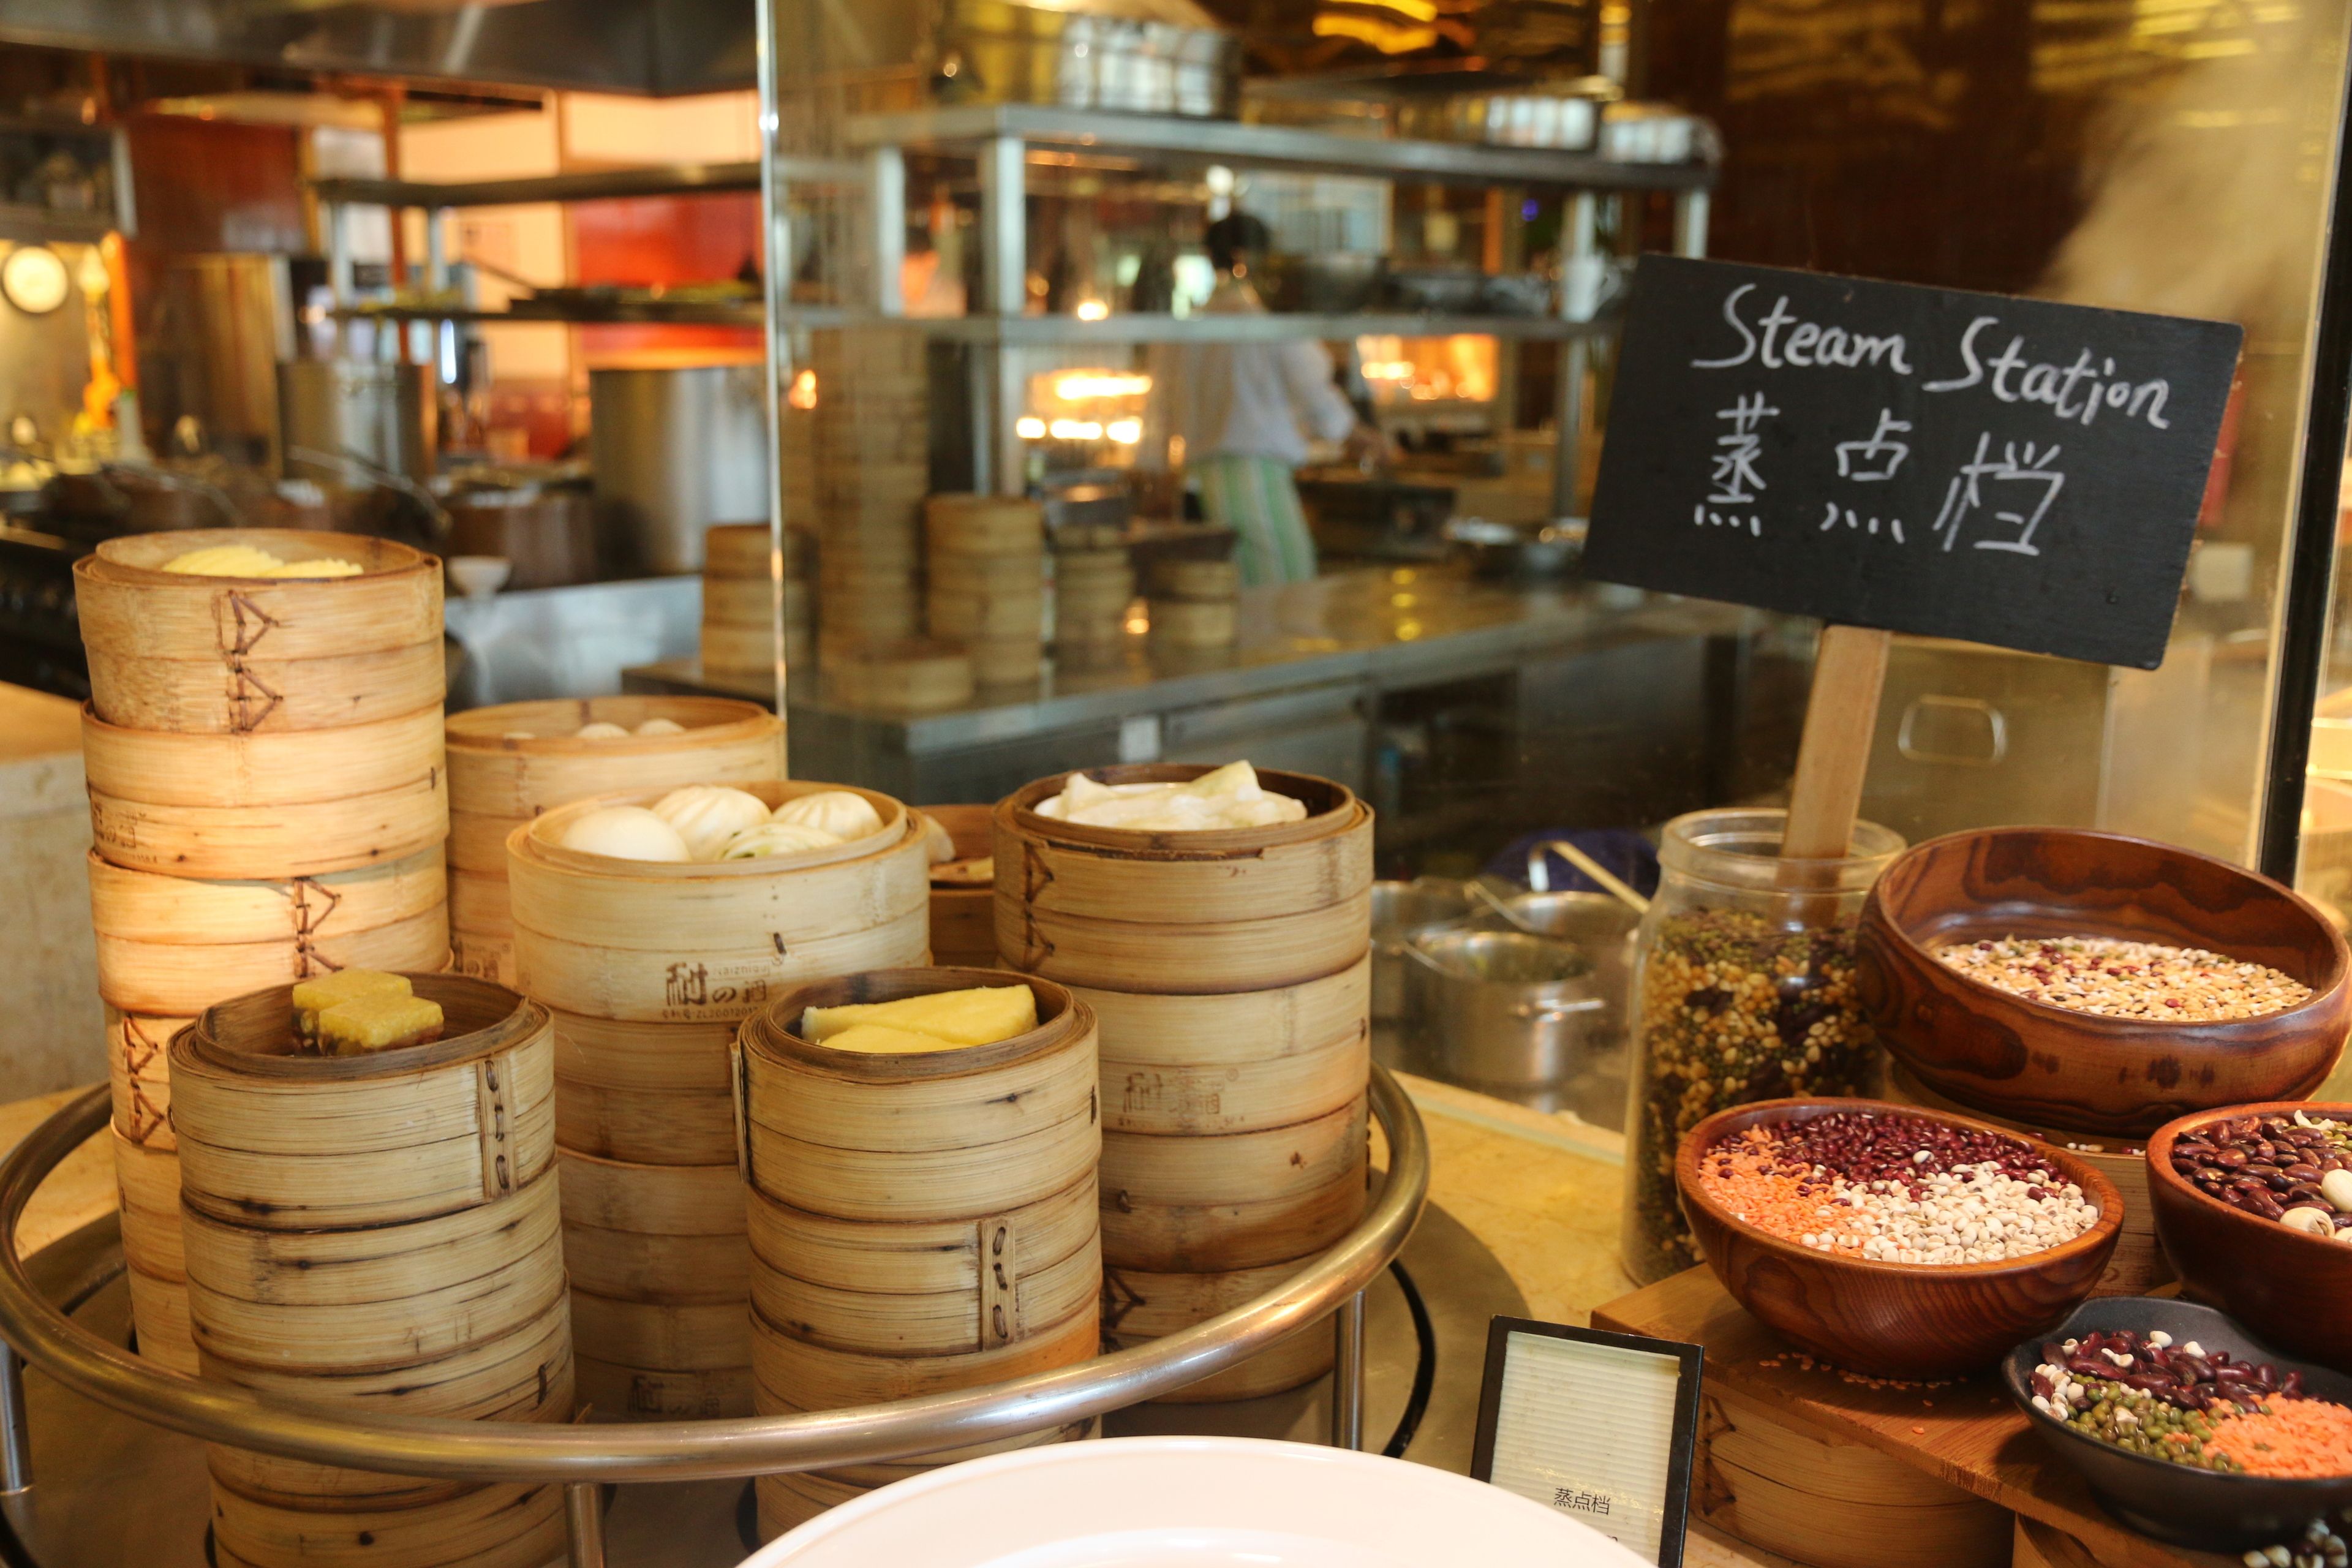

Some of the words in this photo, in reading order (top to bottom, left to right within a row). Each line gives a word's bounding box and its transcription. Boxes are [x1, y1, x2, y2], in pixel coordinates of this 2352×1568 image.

[1691, 283, 1913, 375] Steam
[1923, 315, 2170, 429] Station
[1694, 391, 2064, 556] 蒸点档
[1554, 1487, 1610, 1515] 蒸点档
